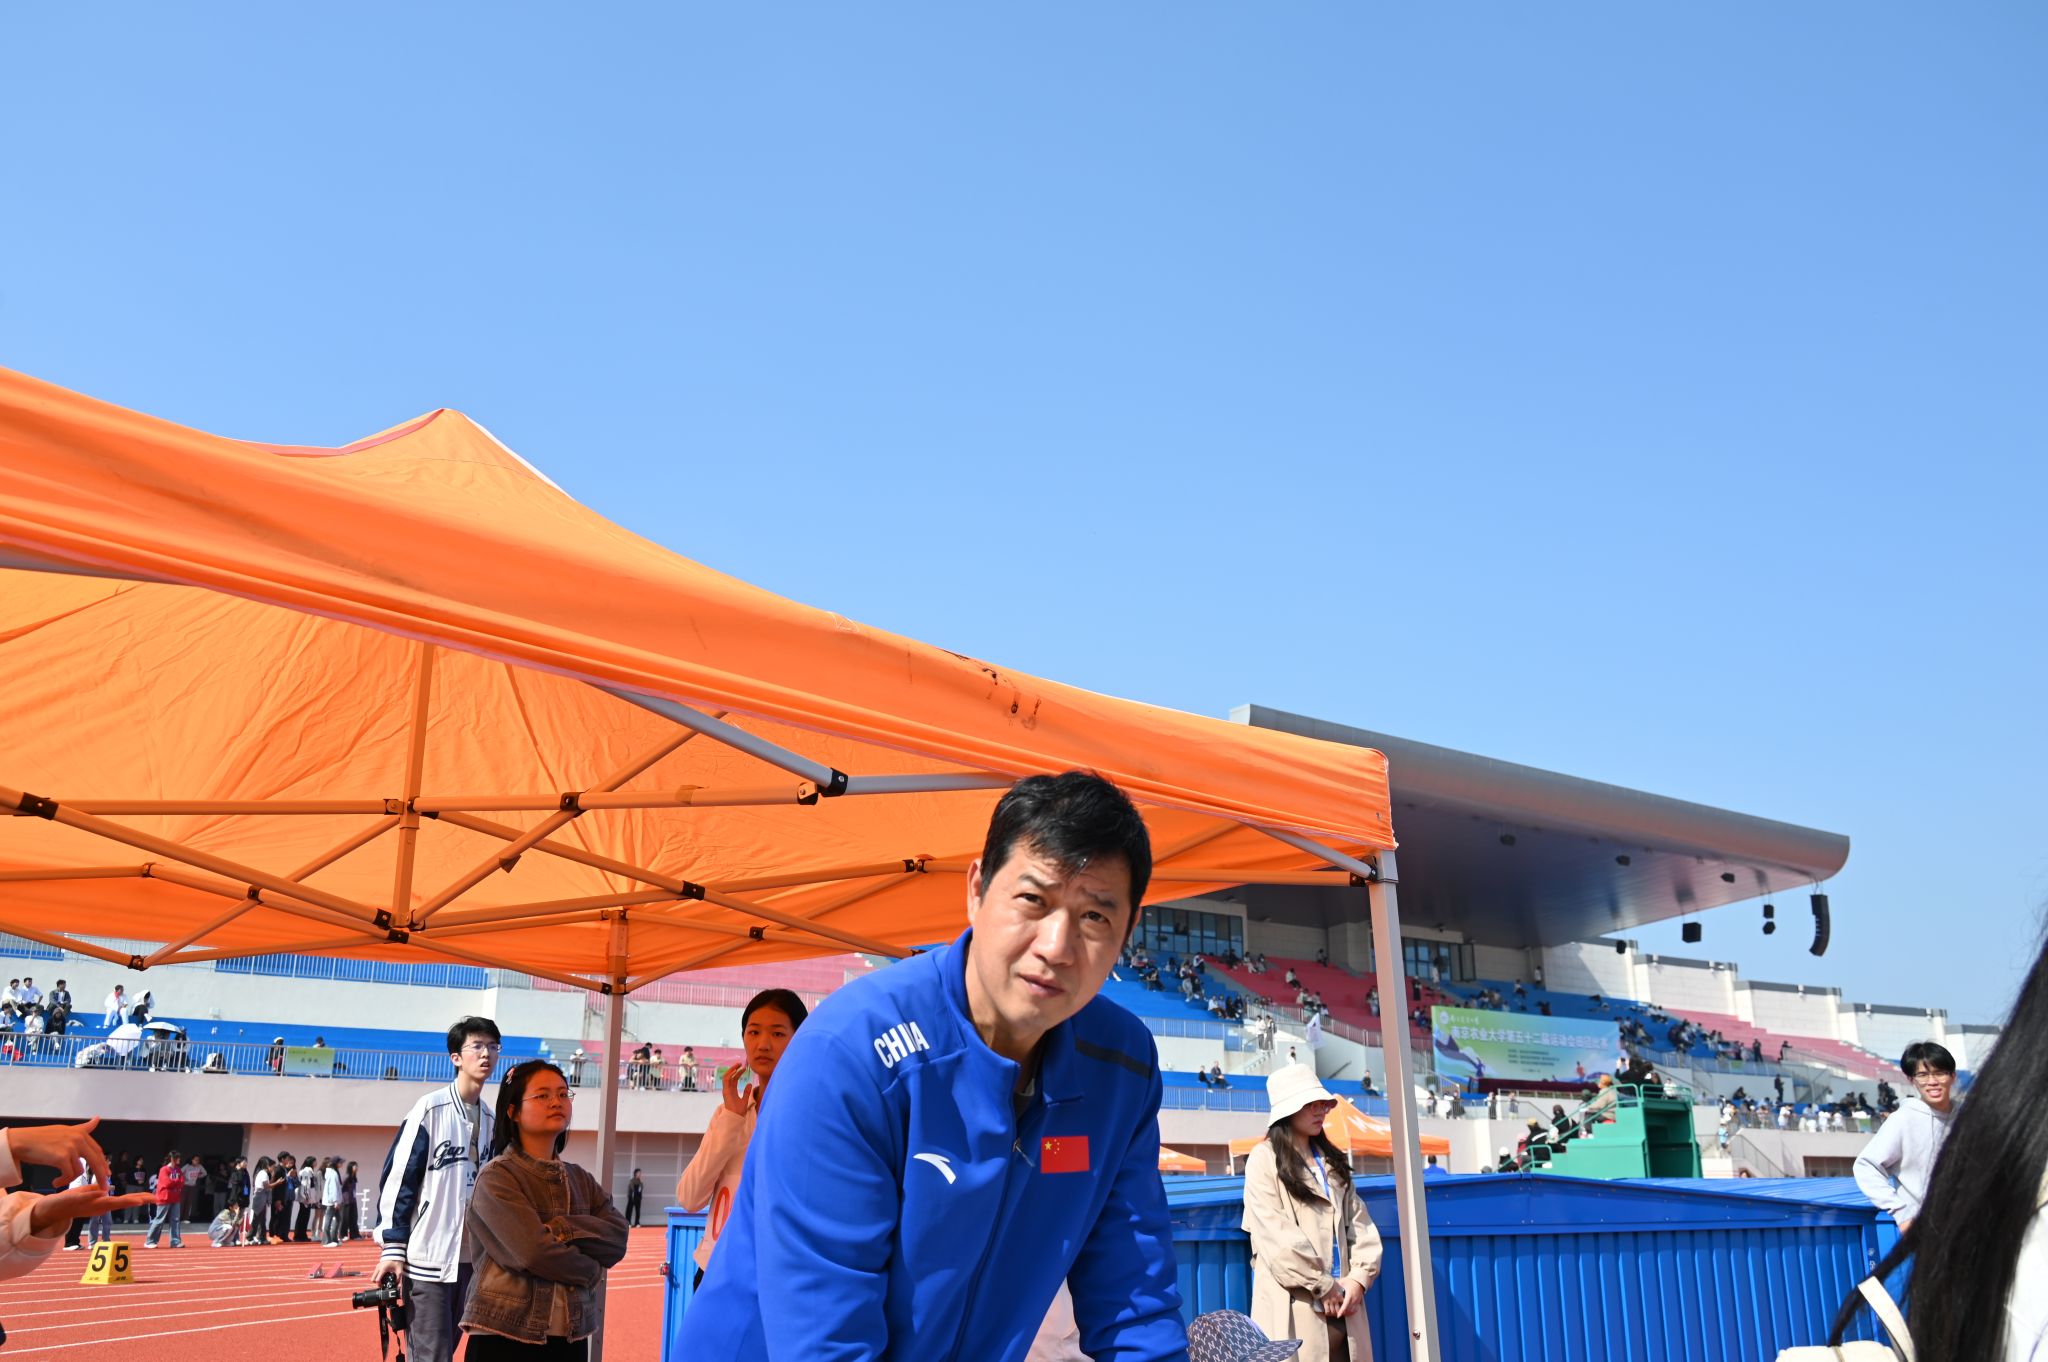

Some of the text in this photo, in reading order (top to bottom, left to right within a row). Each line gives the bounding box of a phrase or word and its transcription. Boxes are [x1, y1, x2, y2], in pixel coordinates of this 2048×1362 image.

[874, 1021, 930, 1069] CHIA
[92, 1246, 109, 1272] 5
[115, 1246, 129, 1272] 5
